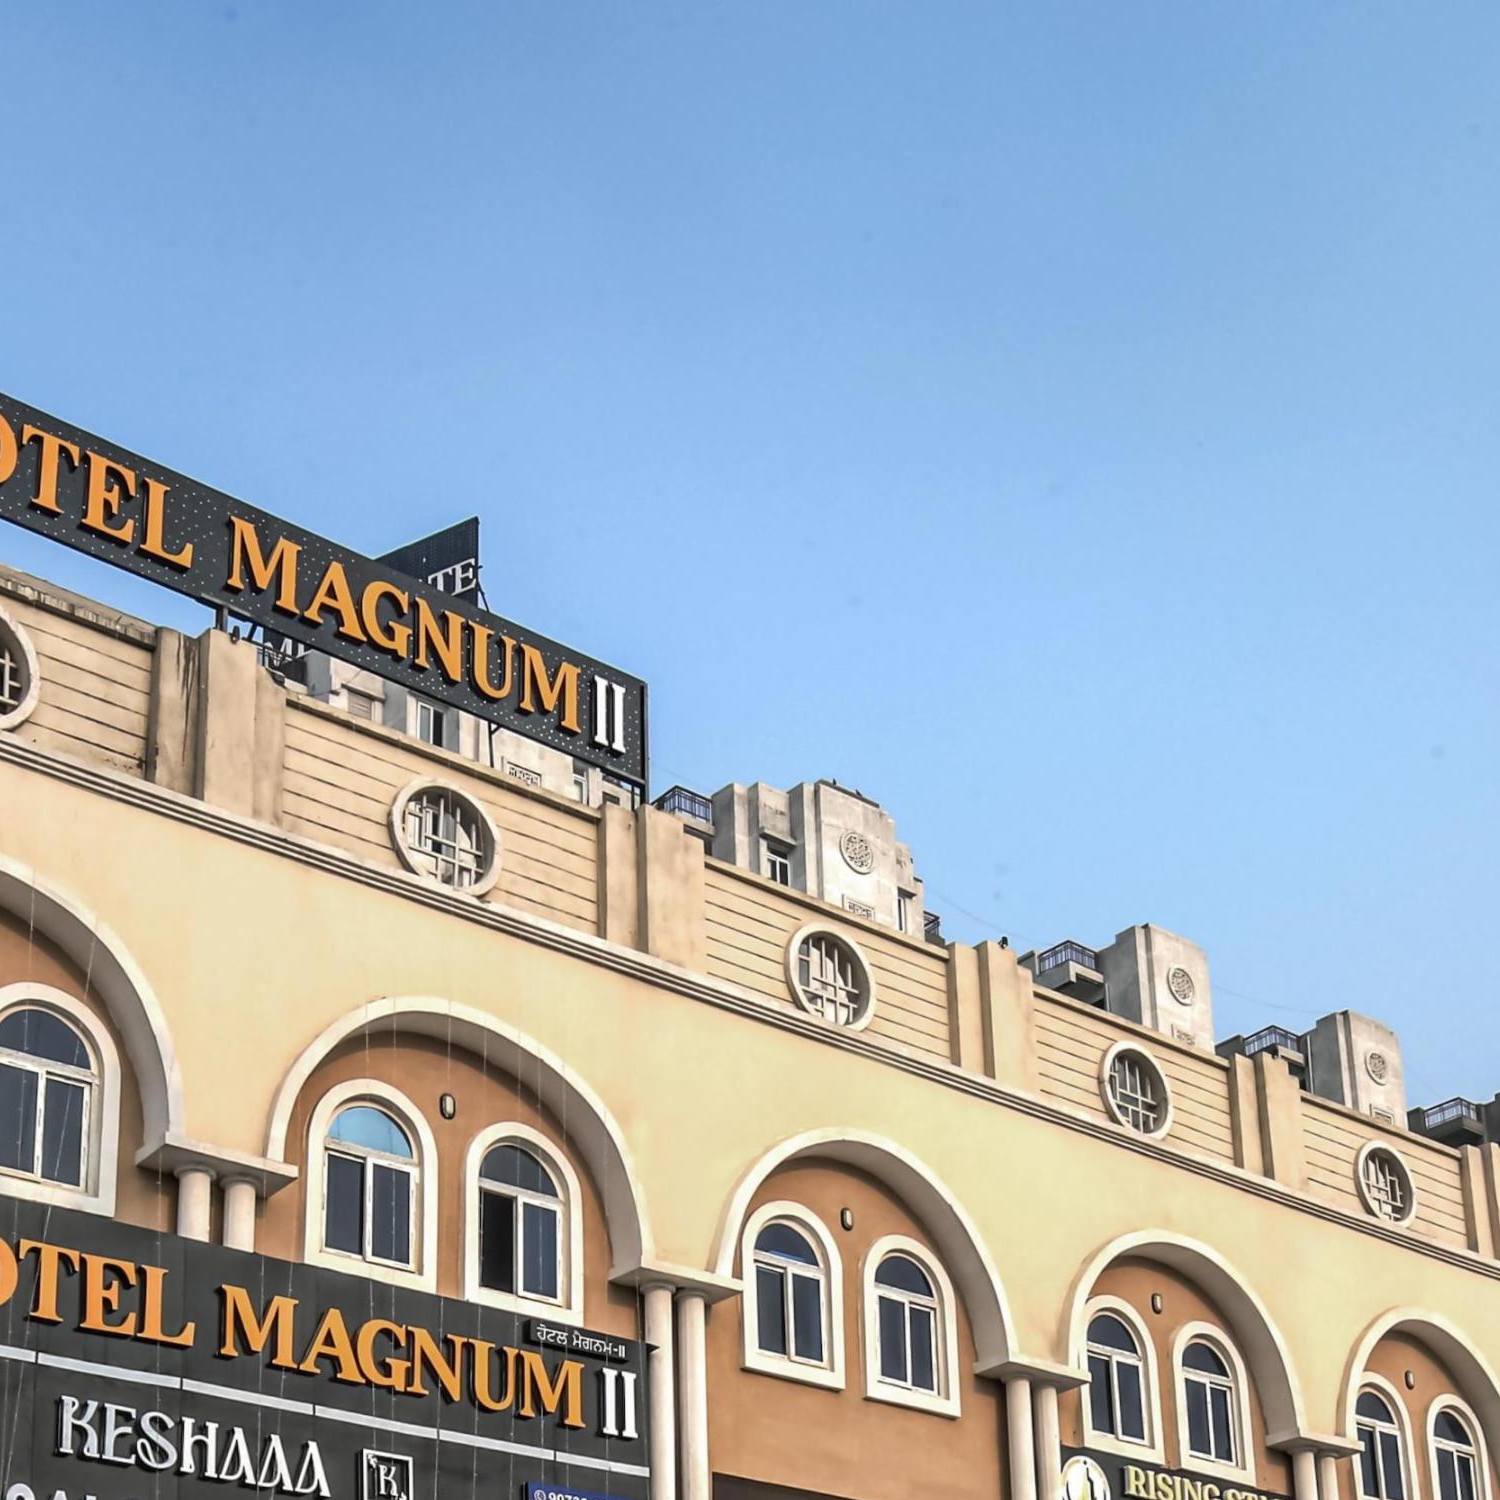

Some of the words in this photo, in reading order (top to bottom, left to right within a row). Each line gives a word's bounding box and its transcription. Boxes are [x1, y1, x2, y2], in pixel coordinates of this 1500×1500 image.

[226, 514, 584, 734] MAGNUM
[590, 673, 627, 754] II
[218, 1283, 587, 1429] MAGNUM
[601, 1366, 639, 1440] II
